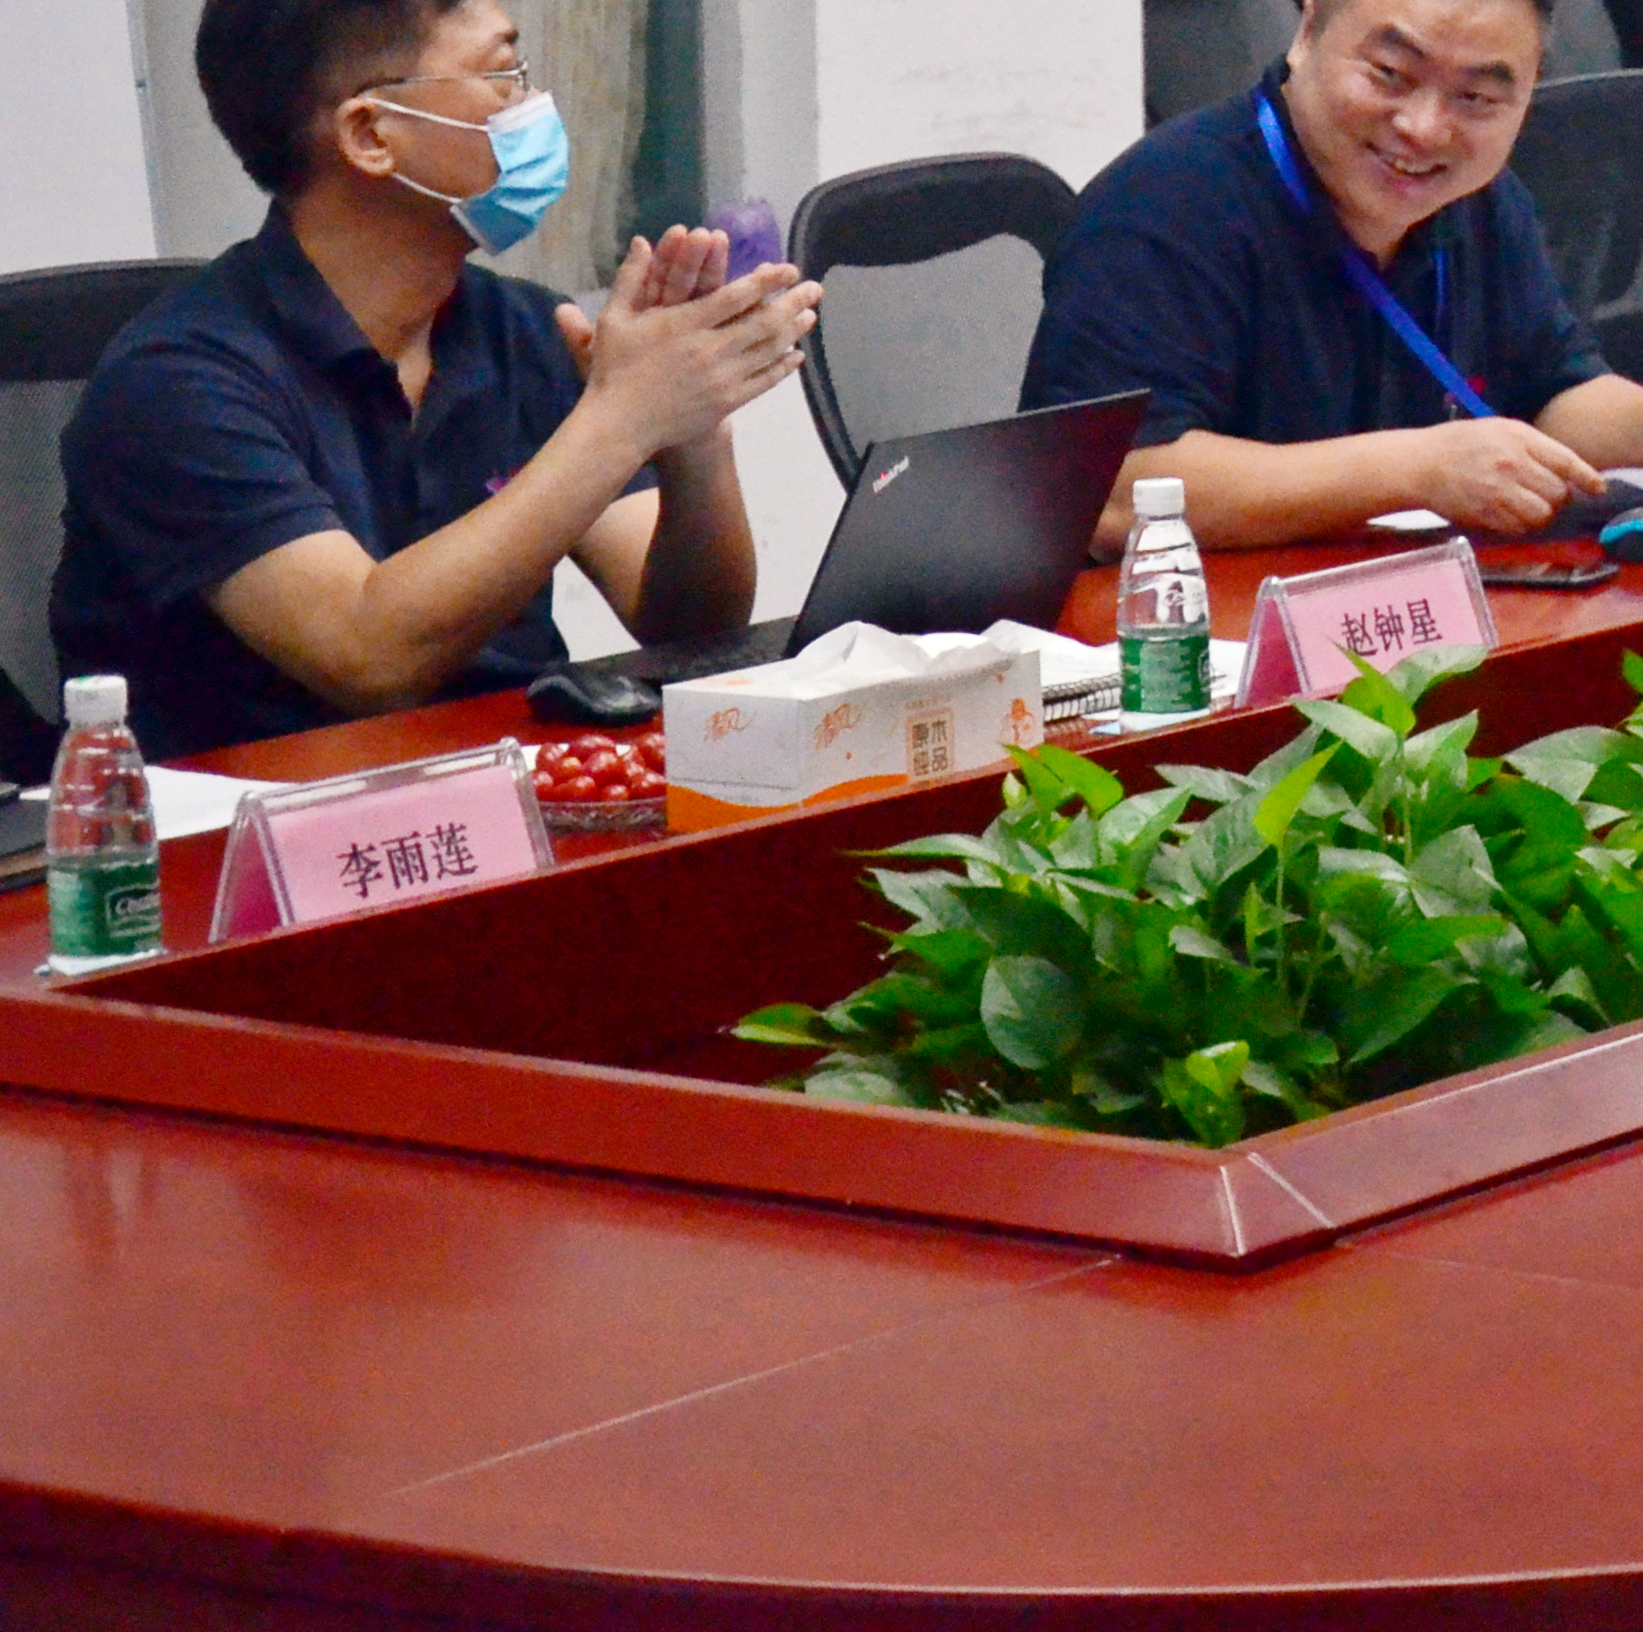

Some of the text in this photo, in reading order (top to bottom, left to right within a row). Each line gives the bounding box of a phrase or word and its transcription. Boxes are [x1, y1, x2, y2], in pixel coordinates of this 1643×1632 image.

[1341, 597, 1443, 656] 赵钟星
[336, 822, 479, 899] 李雨莲
